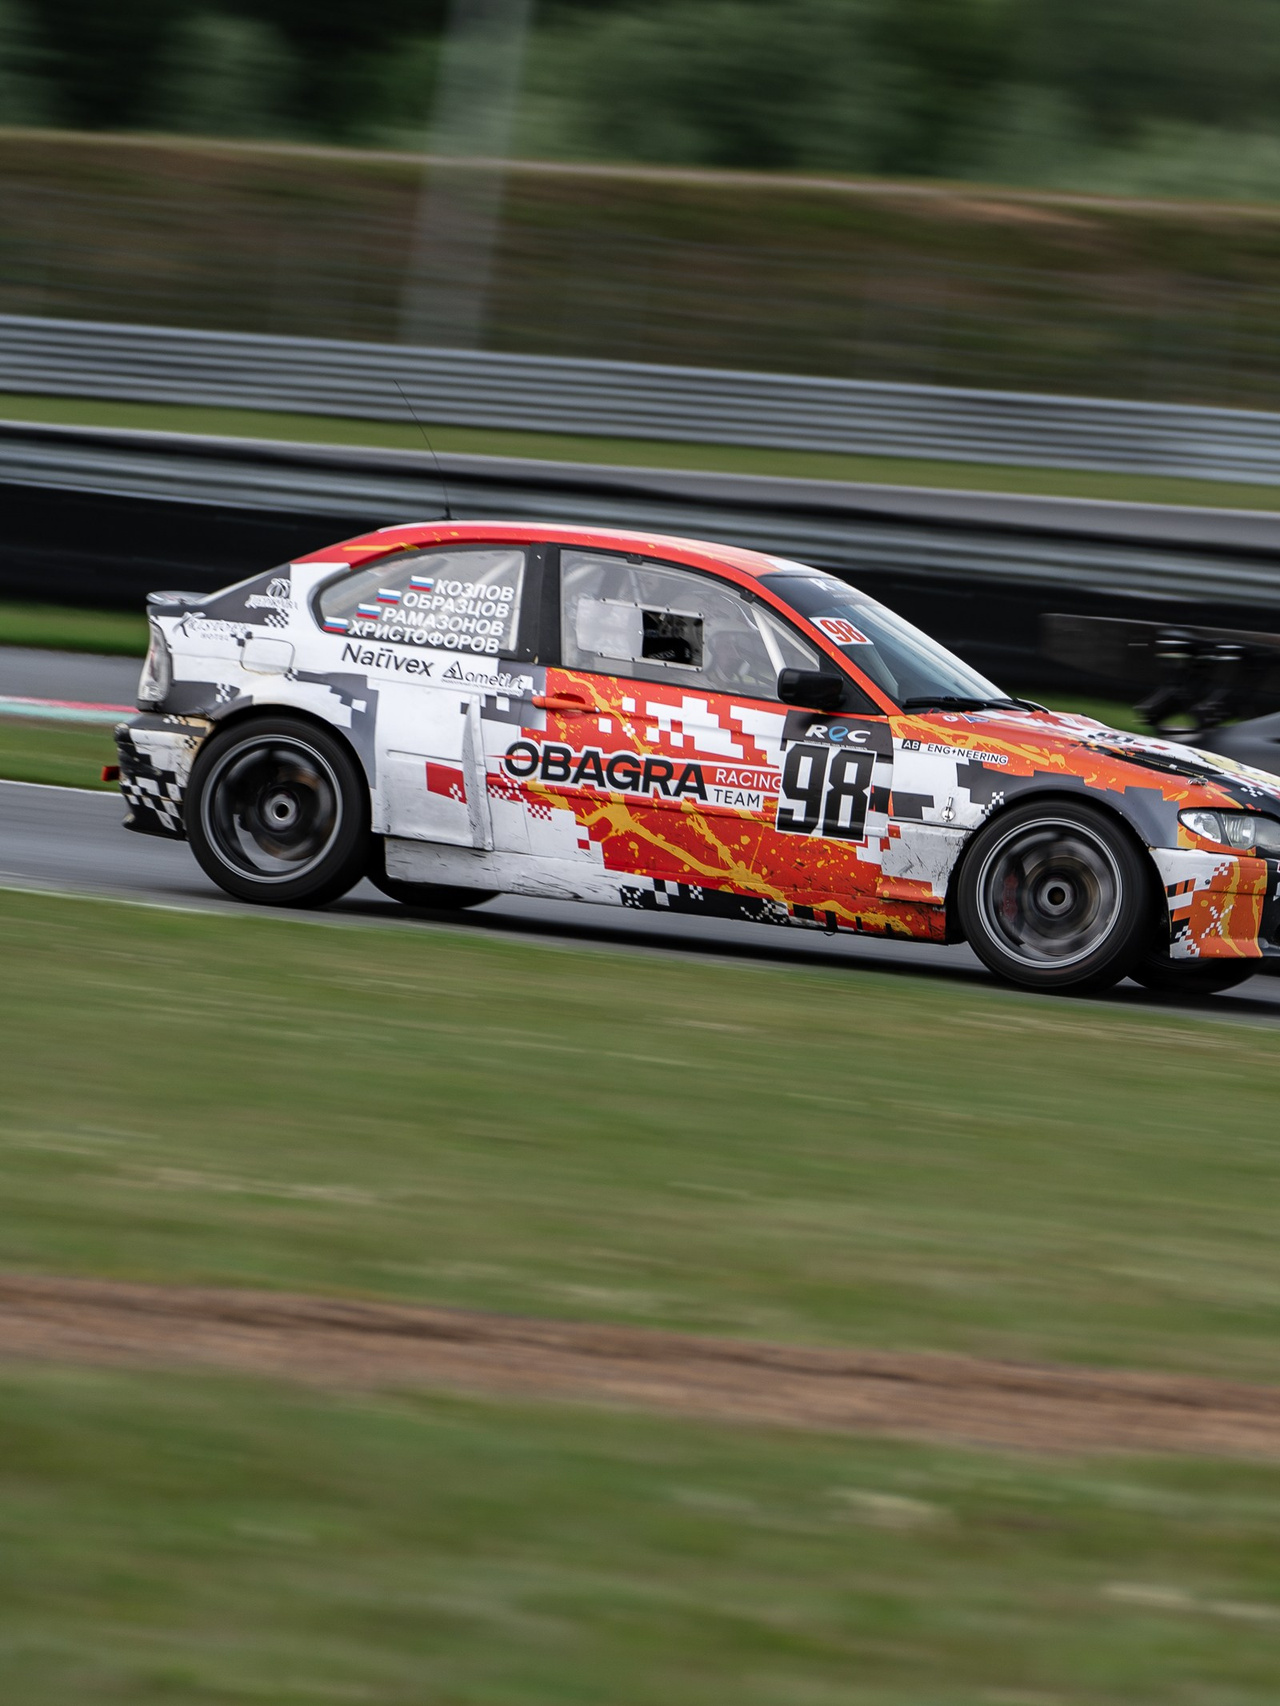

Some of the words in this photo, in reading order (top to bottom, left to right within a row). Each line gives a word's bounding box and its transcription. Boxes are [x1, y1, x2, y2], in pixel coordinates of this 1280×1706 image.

[434, 579, 515, 601] КОЗЛОВ
[402, 592, 510, 618] ОБРАЗЦОВ
[382, 607, 505, 637] РАМАЗОНОВ
[820, 619, 867, 643] 98
[349, 619, 500, 654] ХРИСТОФОРОВ
[903, 739, 920, 750] AB
[504, 740, 709, 801] OBAGRA
[715, 768, 782, 790] RACING
[714, 789, 760, 808] TEAM
[776, 742, 875, 840] 98
